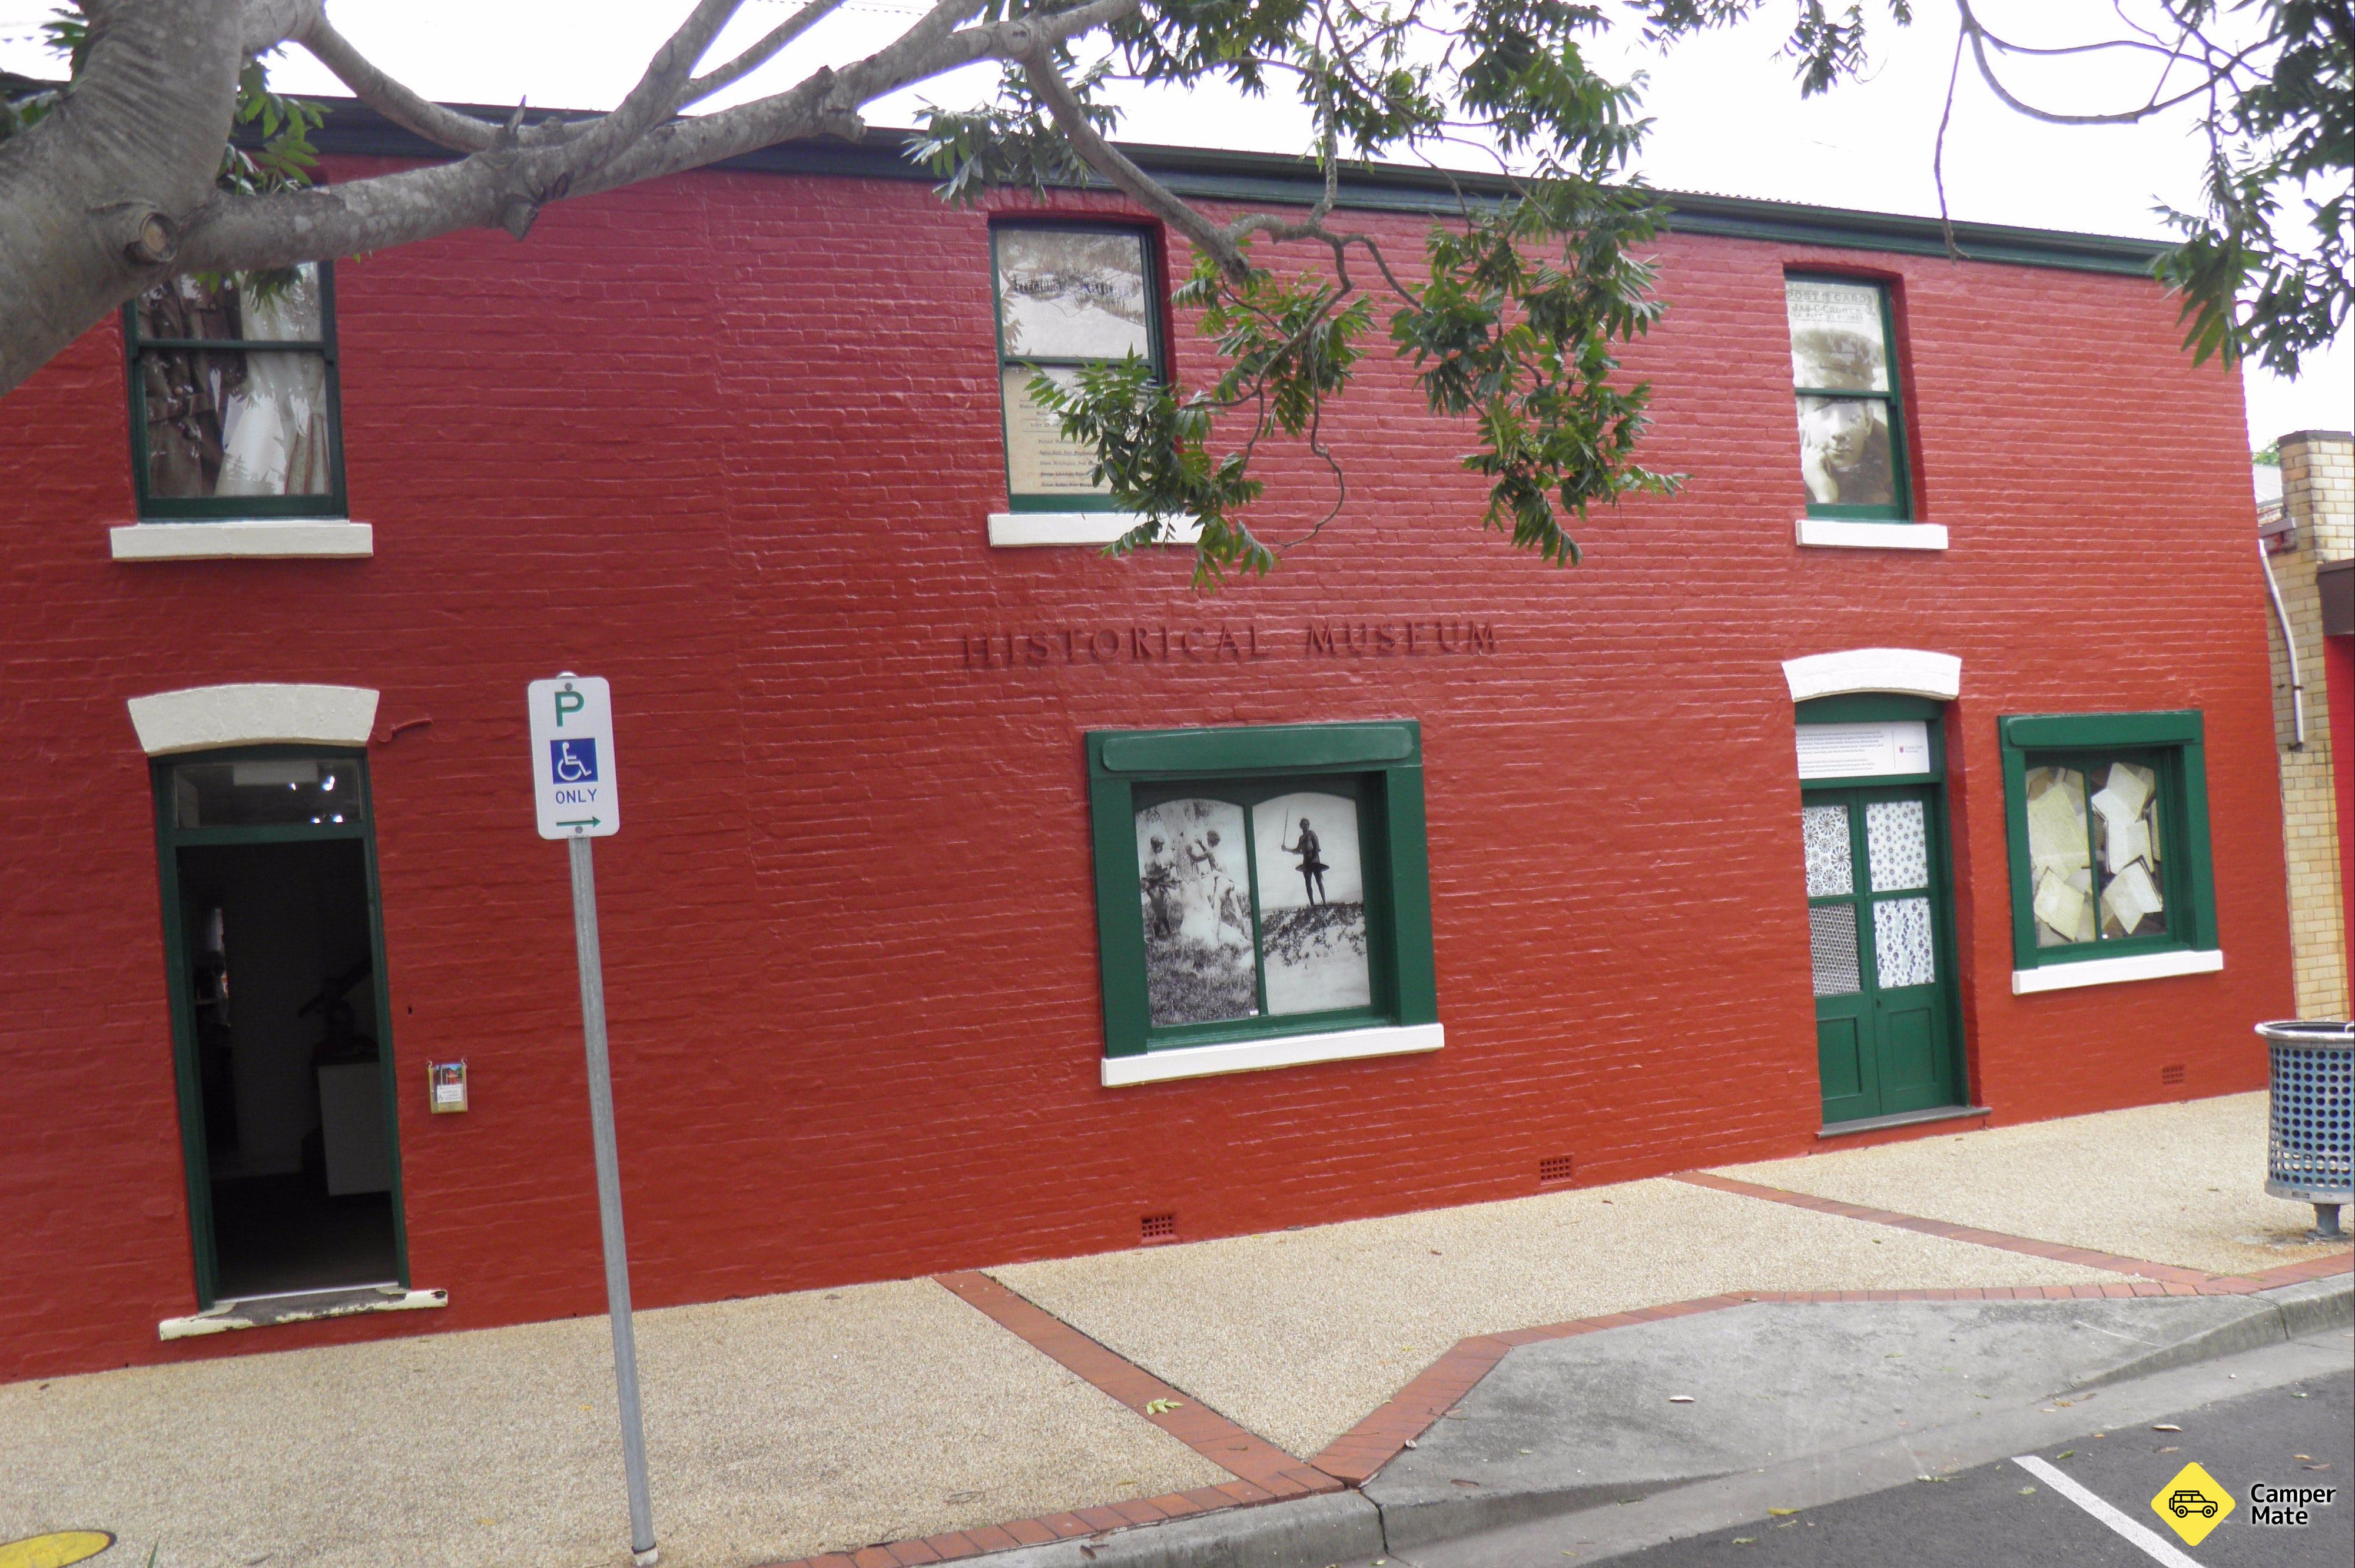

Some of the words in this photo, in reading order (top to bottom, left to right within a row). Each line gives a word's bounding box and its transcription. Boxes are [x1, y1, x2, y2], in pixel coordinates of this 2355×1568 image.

[1787, 291, 1819, 300] POST
[964, 623, 1269, 663] HISTORICAL
[1307, 619, 1497, 654] MUSEUM
[555, 690, 584, 727] P
[556, 789, 598, 805] ONLY
